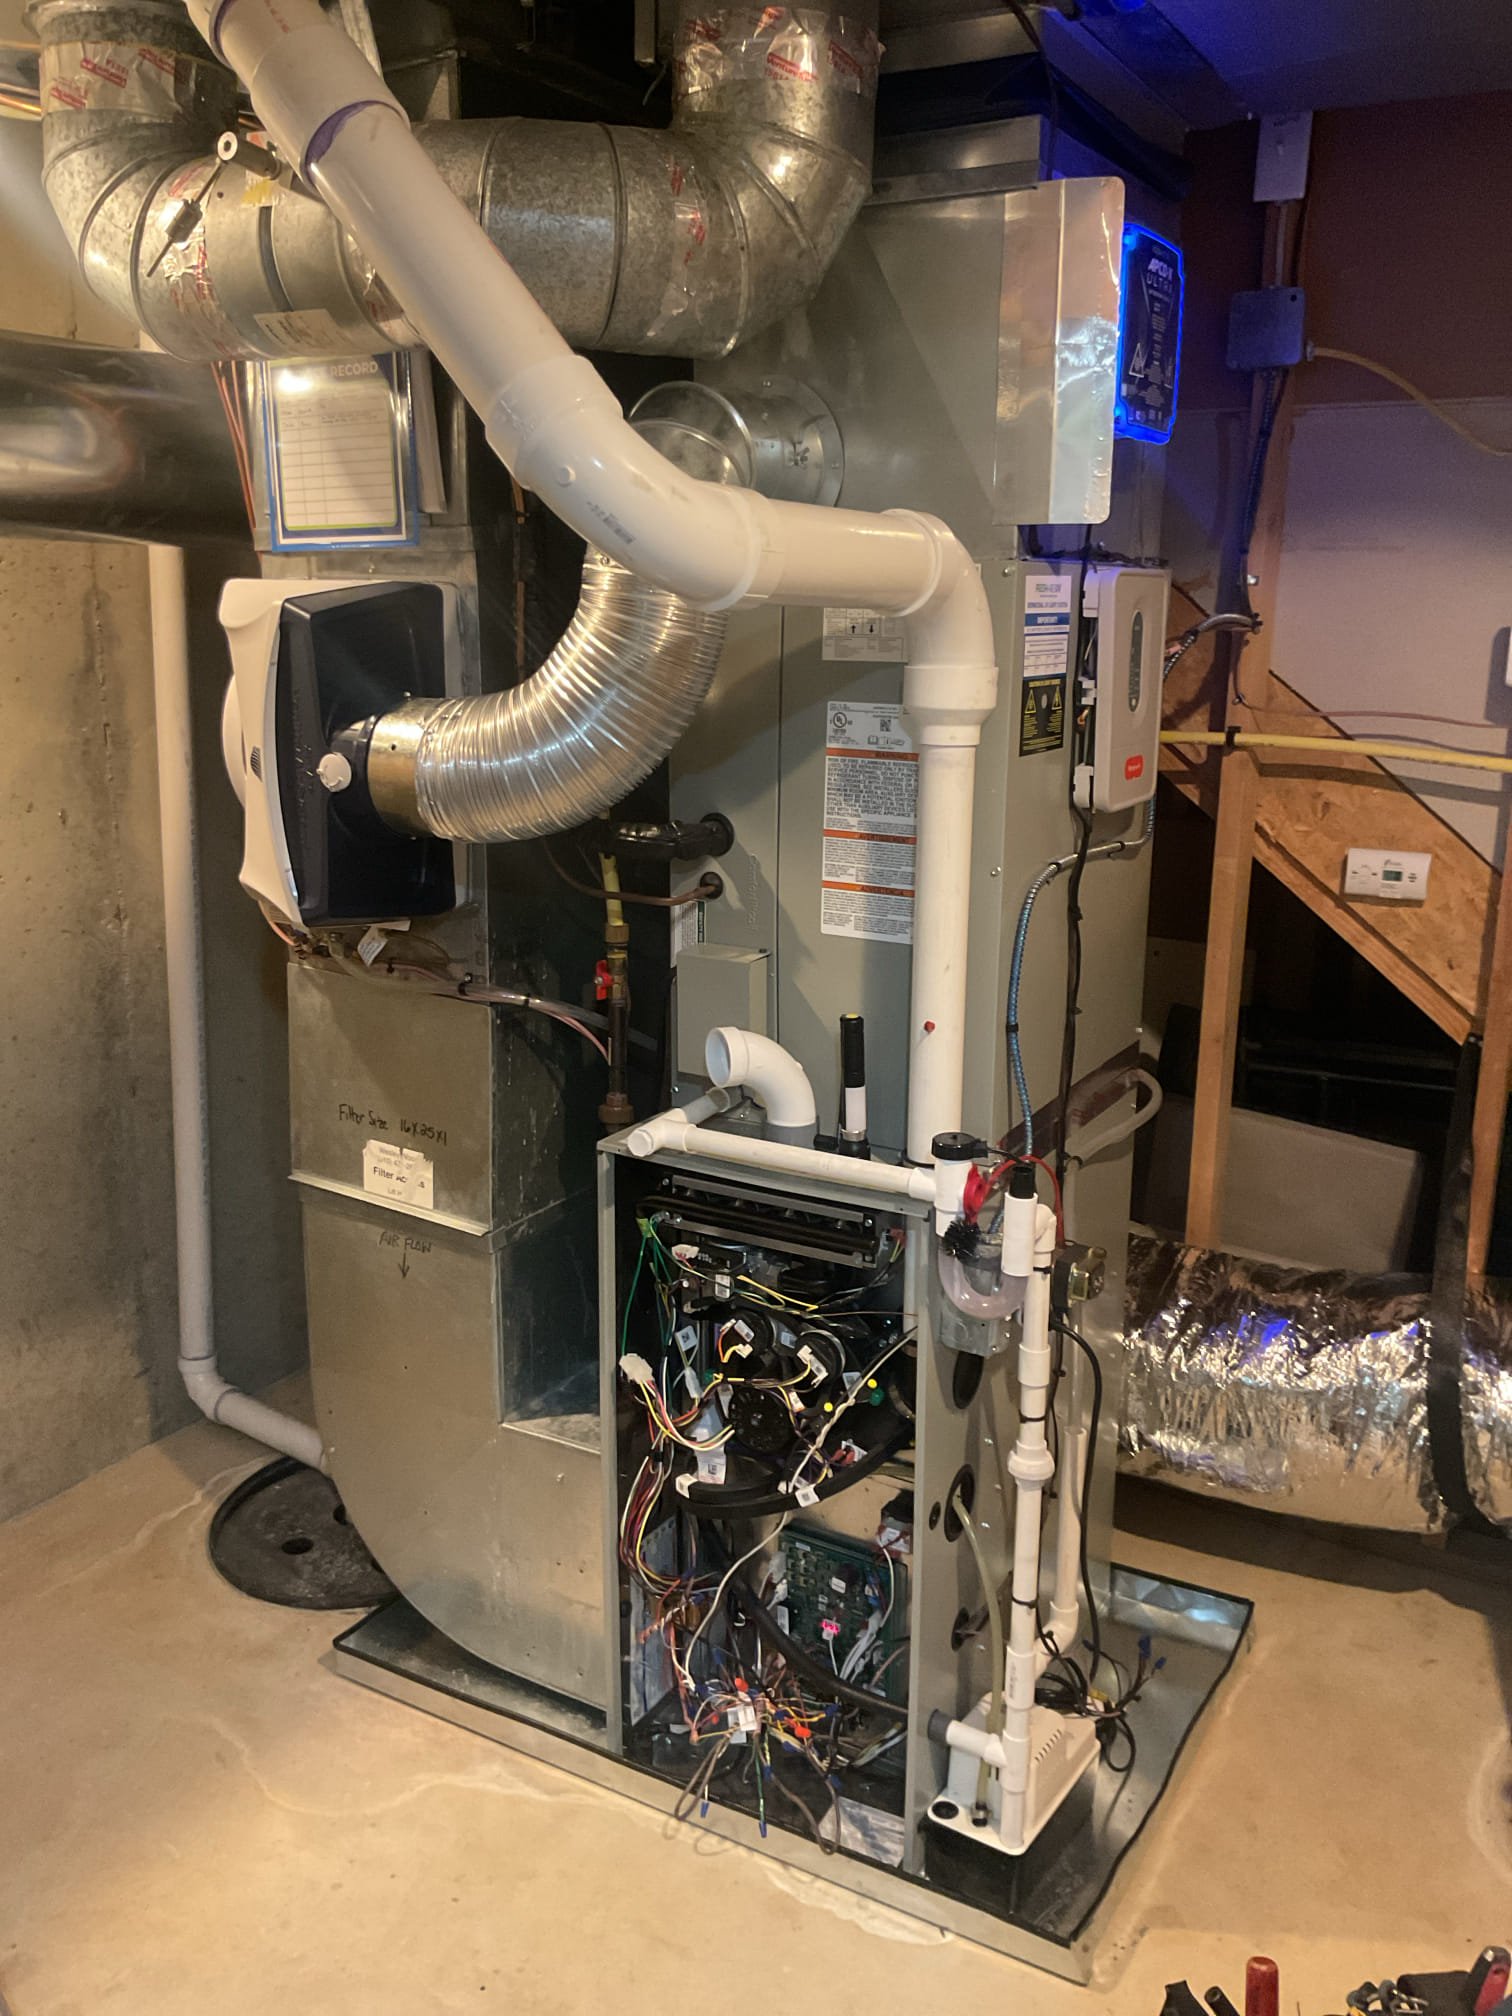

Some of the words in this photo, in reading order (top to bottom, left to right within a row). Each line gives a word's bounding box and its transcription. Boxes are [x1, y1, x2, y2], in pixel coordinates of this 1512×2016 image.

[330, 360, 379, 378] RECORD
[339, 1103, 365, 1124] Filter
[368, 1110, 388, 1130] Size
[373, 1165, 394, 1180] Filter
